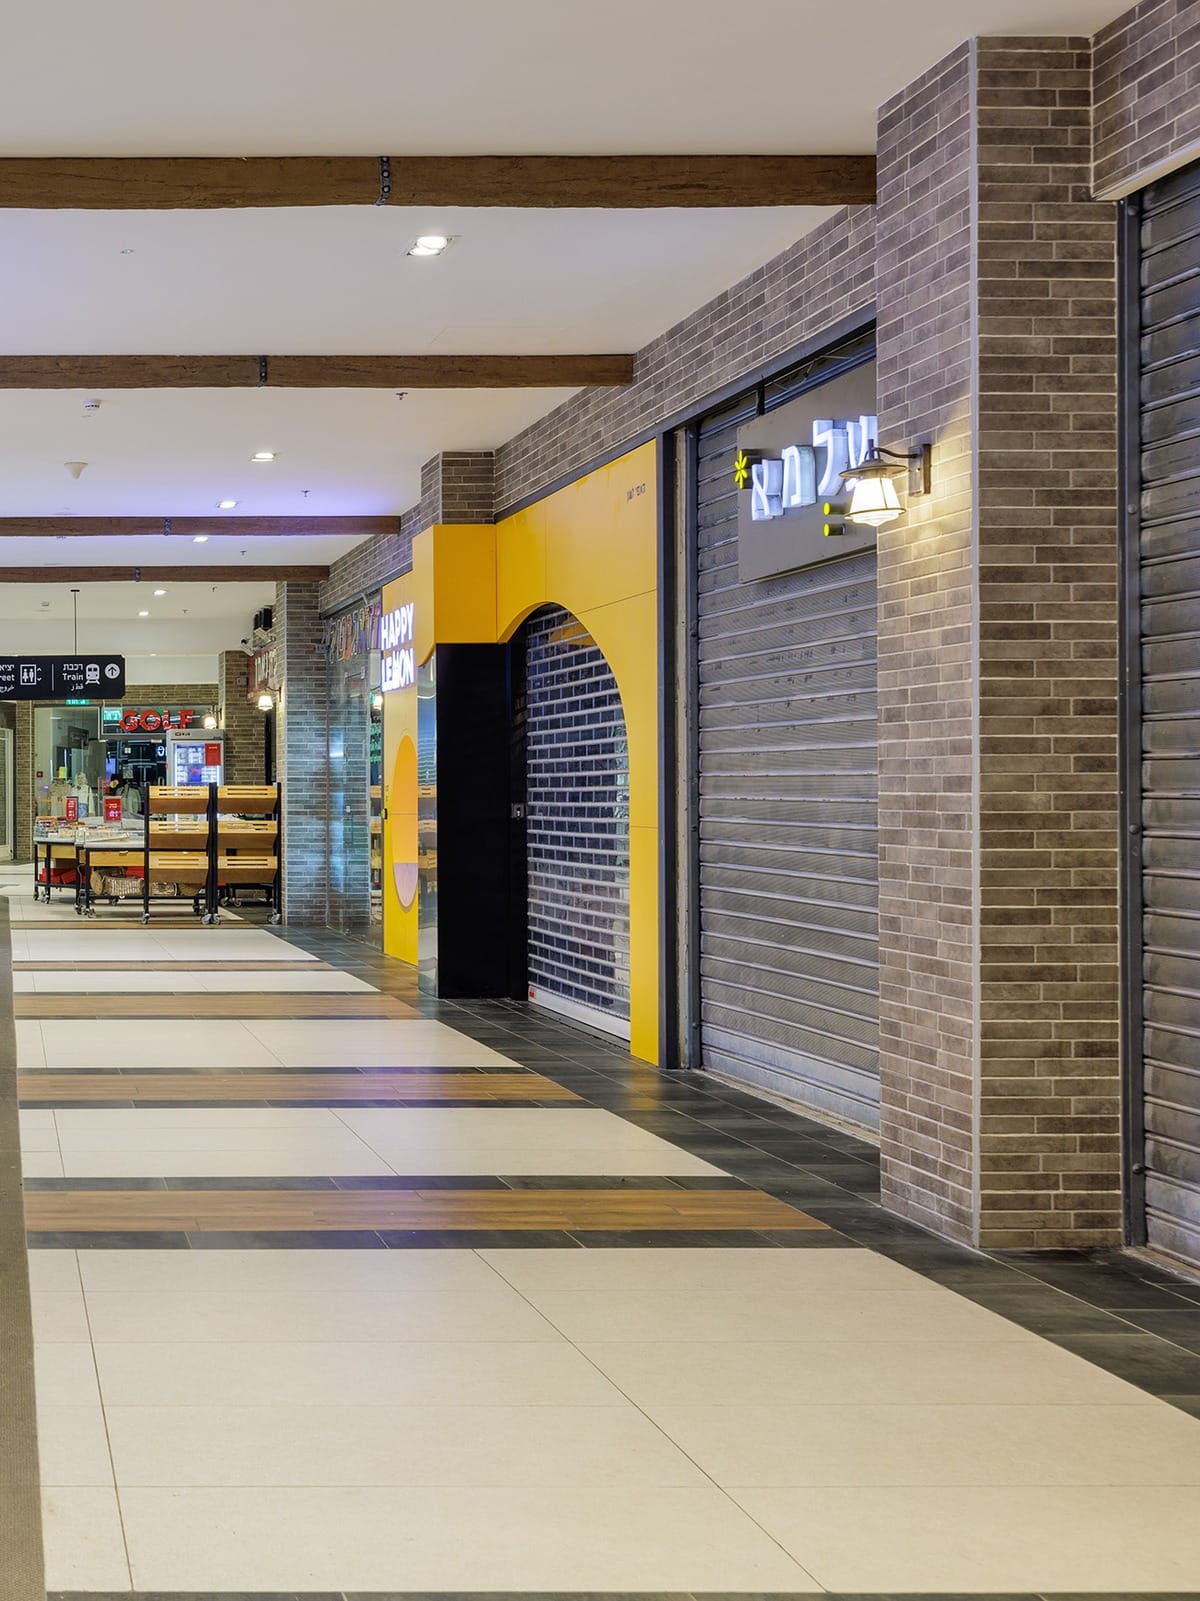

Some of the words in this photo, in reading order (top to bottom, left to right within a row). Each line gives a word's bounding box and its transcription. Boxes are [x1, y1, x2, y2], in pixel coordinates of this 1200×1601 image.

[381, 602, 414, 651] HAPPY
[62, 672, 84, 681] Train
[63, 663, 84, 671] רכבת
[381, 647, 414, 692] LEMON
[119, 709, 195, 731] GOLF
